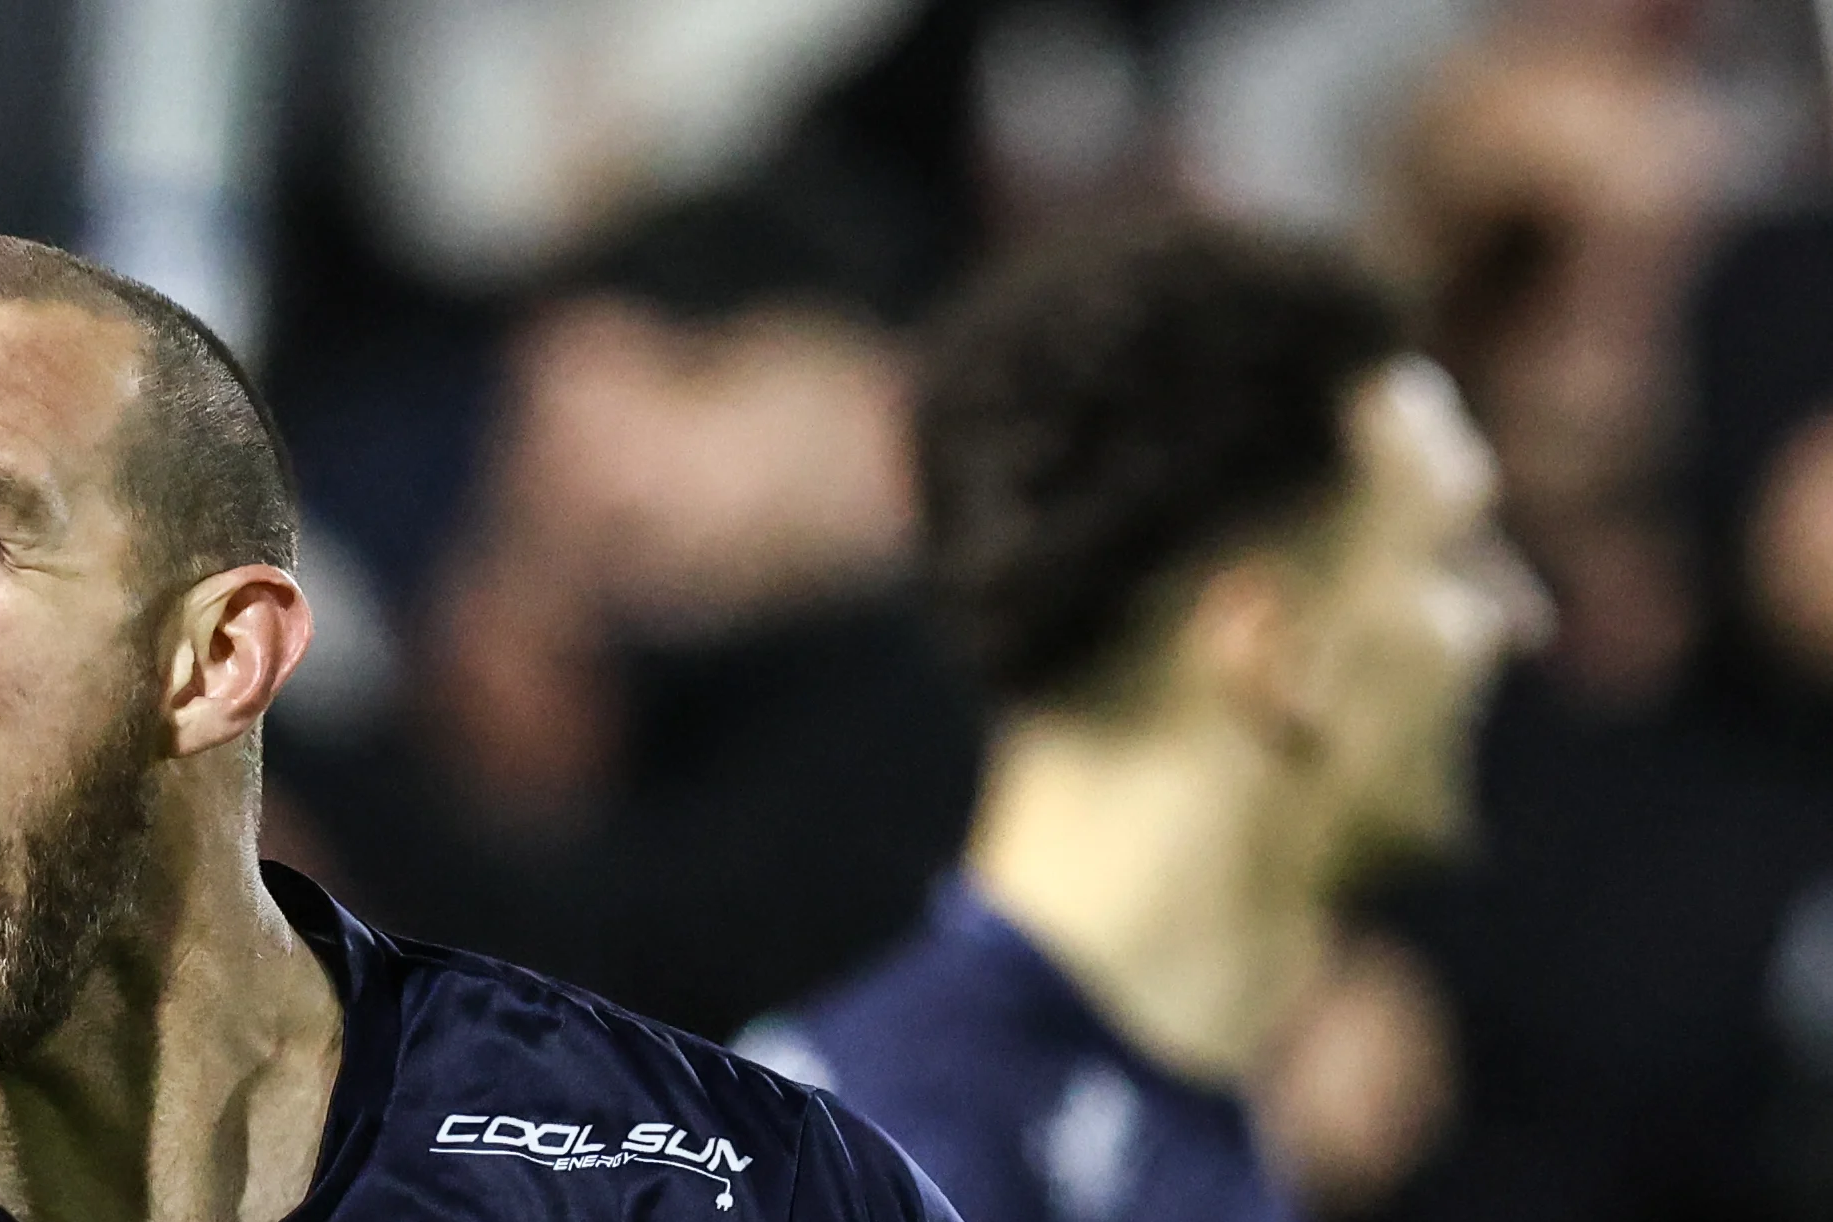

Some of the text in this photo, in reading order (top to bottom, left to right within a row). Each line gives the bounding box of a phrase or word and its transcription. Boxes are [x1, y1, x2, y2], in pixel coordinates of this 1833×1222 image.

[436, 1114, 753, 1172] COOL SUN
[553, 1152, 637, 1171] ENERGY
